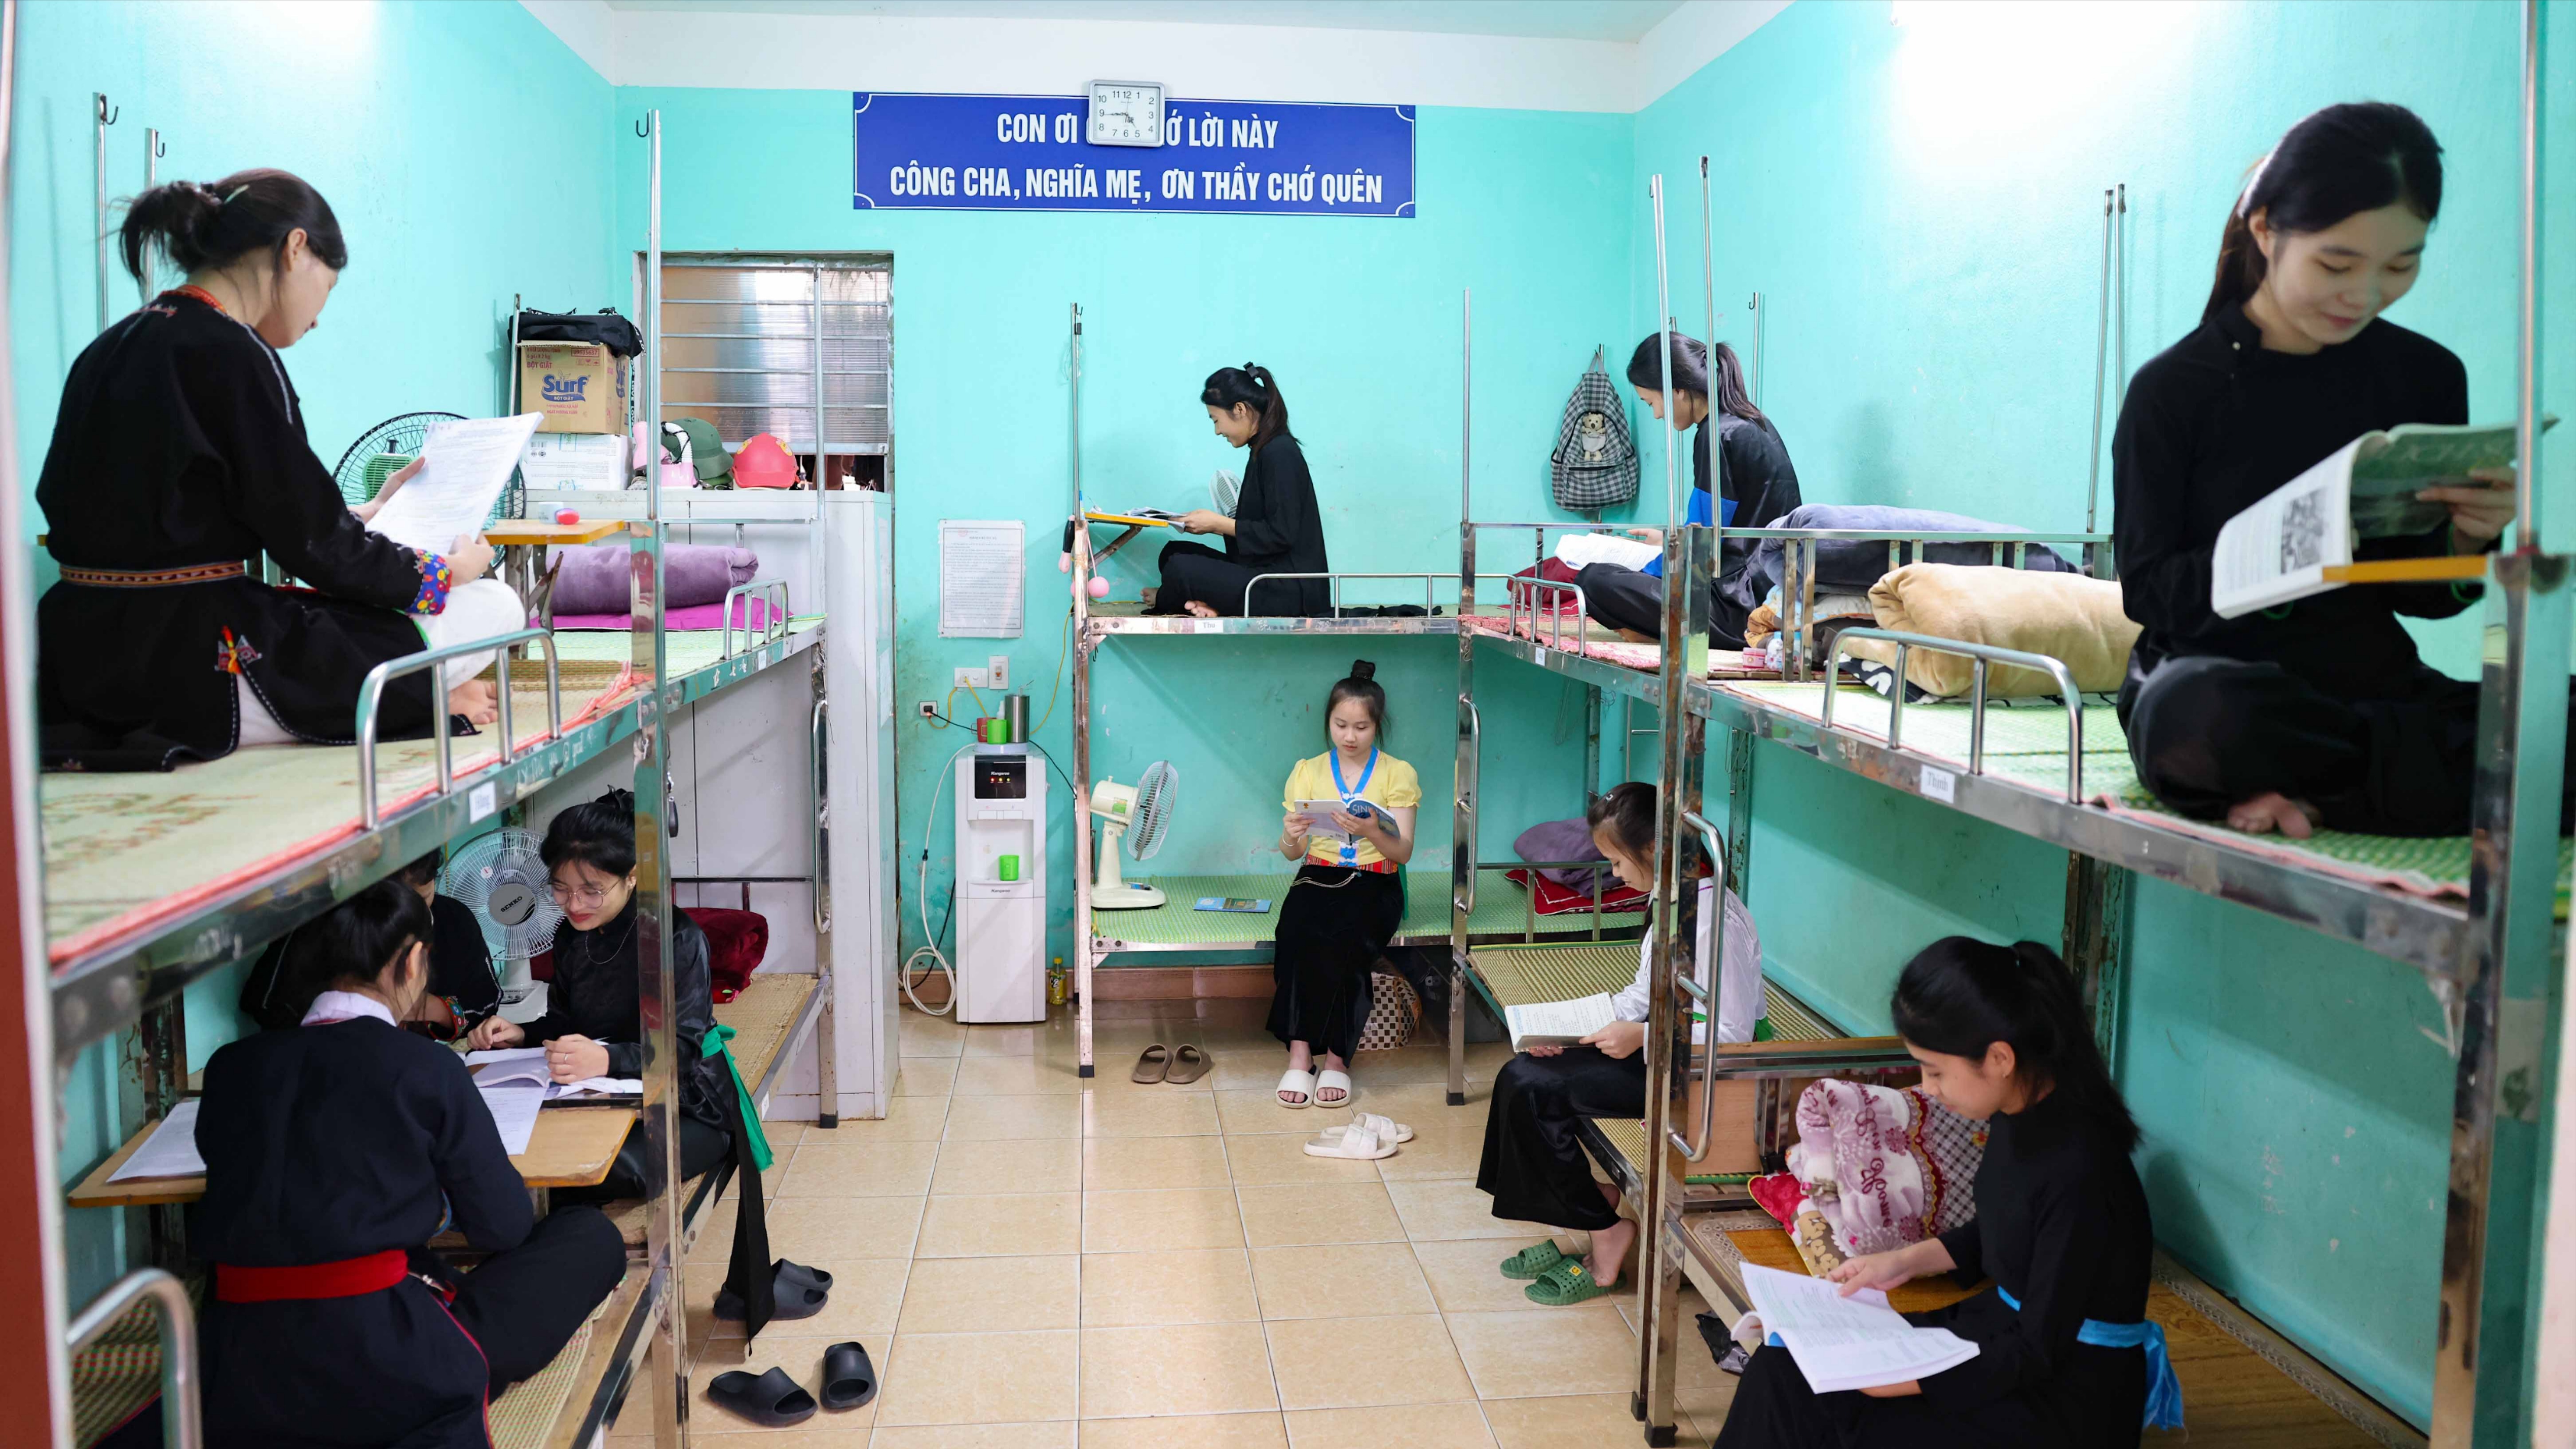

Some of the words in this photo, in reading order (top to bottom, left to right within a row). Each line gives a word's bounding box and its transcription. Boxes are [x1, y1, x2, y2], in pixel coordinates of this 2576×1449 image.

[997, 114, 1045, 143] CON
[1055, 113, 1077, 143] ƠI
[1189, 111, 1223, 147] LỜI
[1232, 114, 1278, 148] NÀY
[891, 160, 955, 196] CÔNG
[964, 167, 1020, 200] CHA,
[1026, 163, 1098, 198] NGHĨA
[1106, 169, 1151, 204] MẸ,
[1162, 169, 1194, 199] ƠN
[1202, 162, 1261, 201] THẦY
[1268, 165, 1315, 202] CHỚ
[1321, 168, 1382, 206] QUÊN
[527, 361, 538, 369] BỘT
[542, 373, 589, 394] Surf
[500, 896, 523, 912] SENKO
